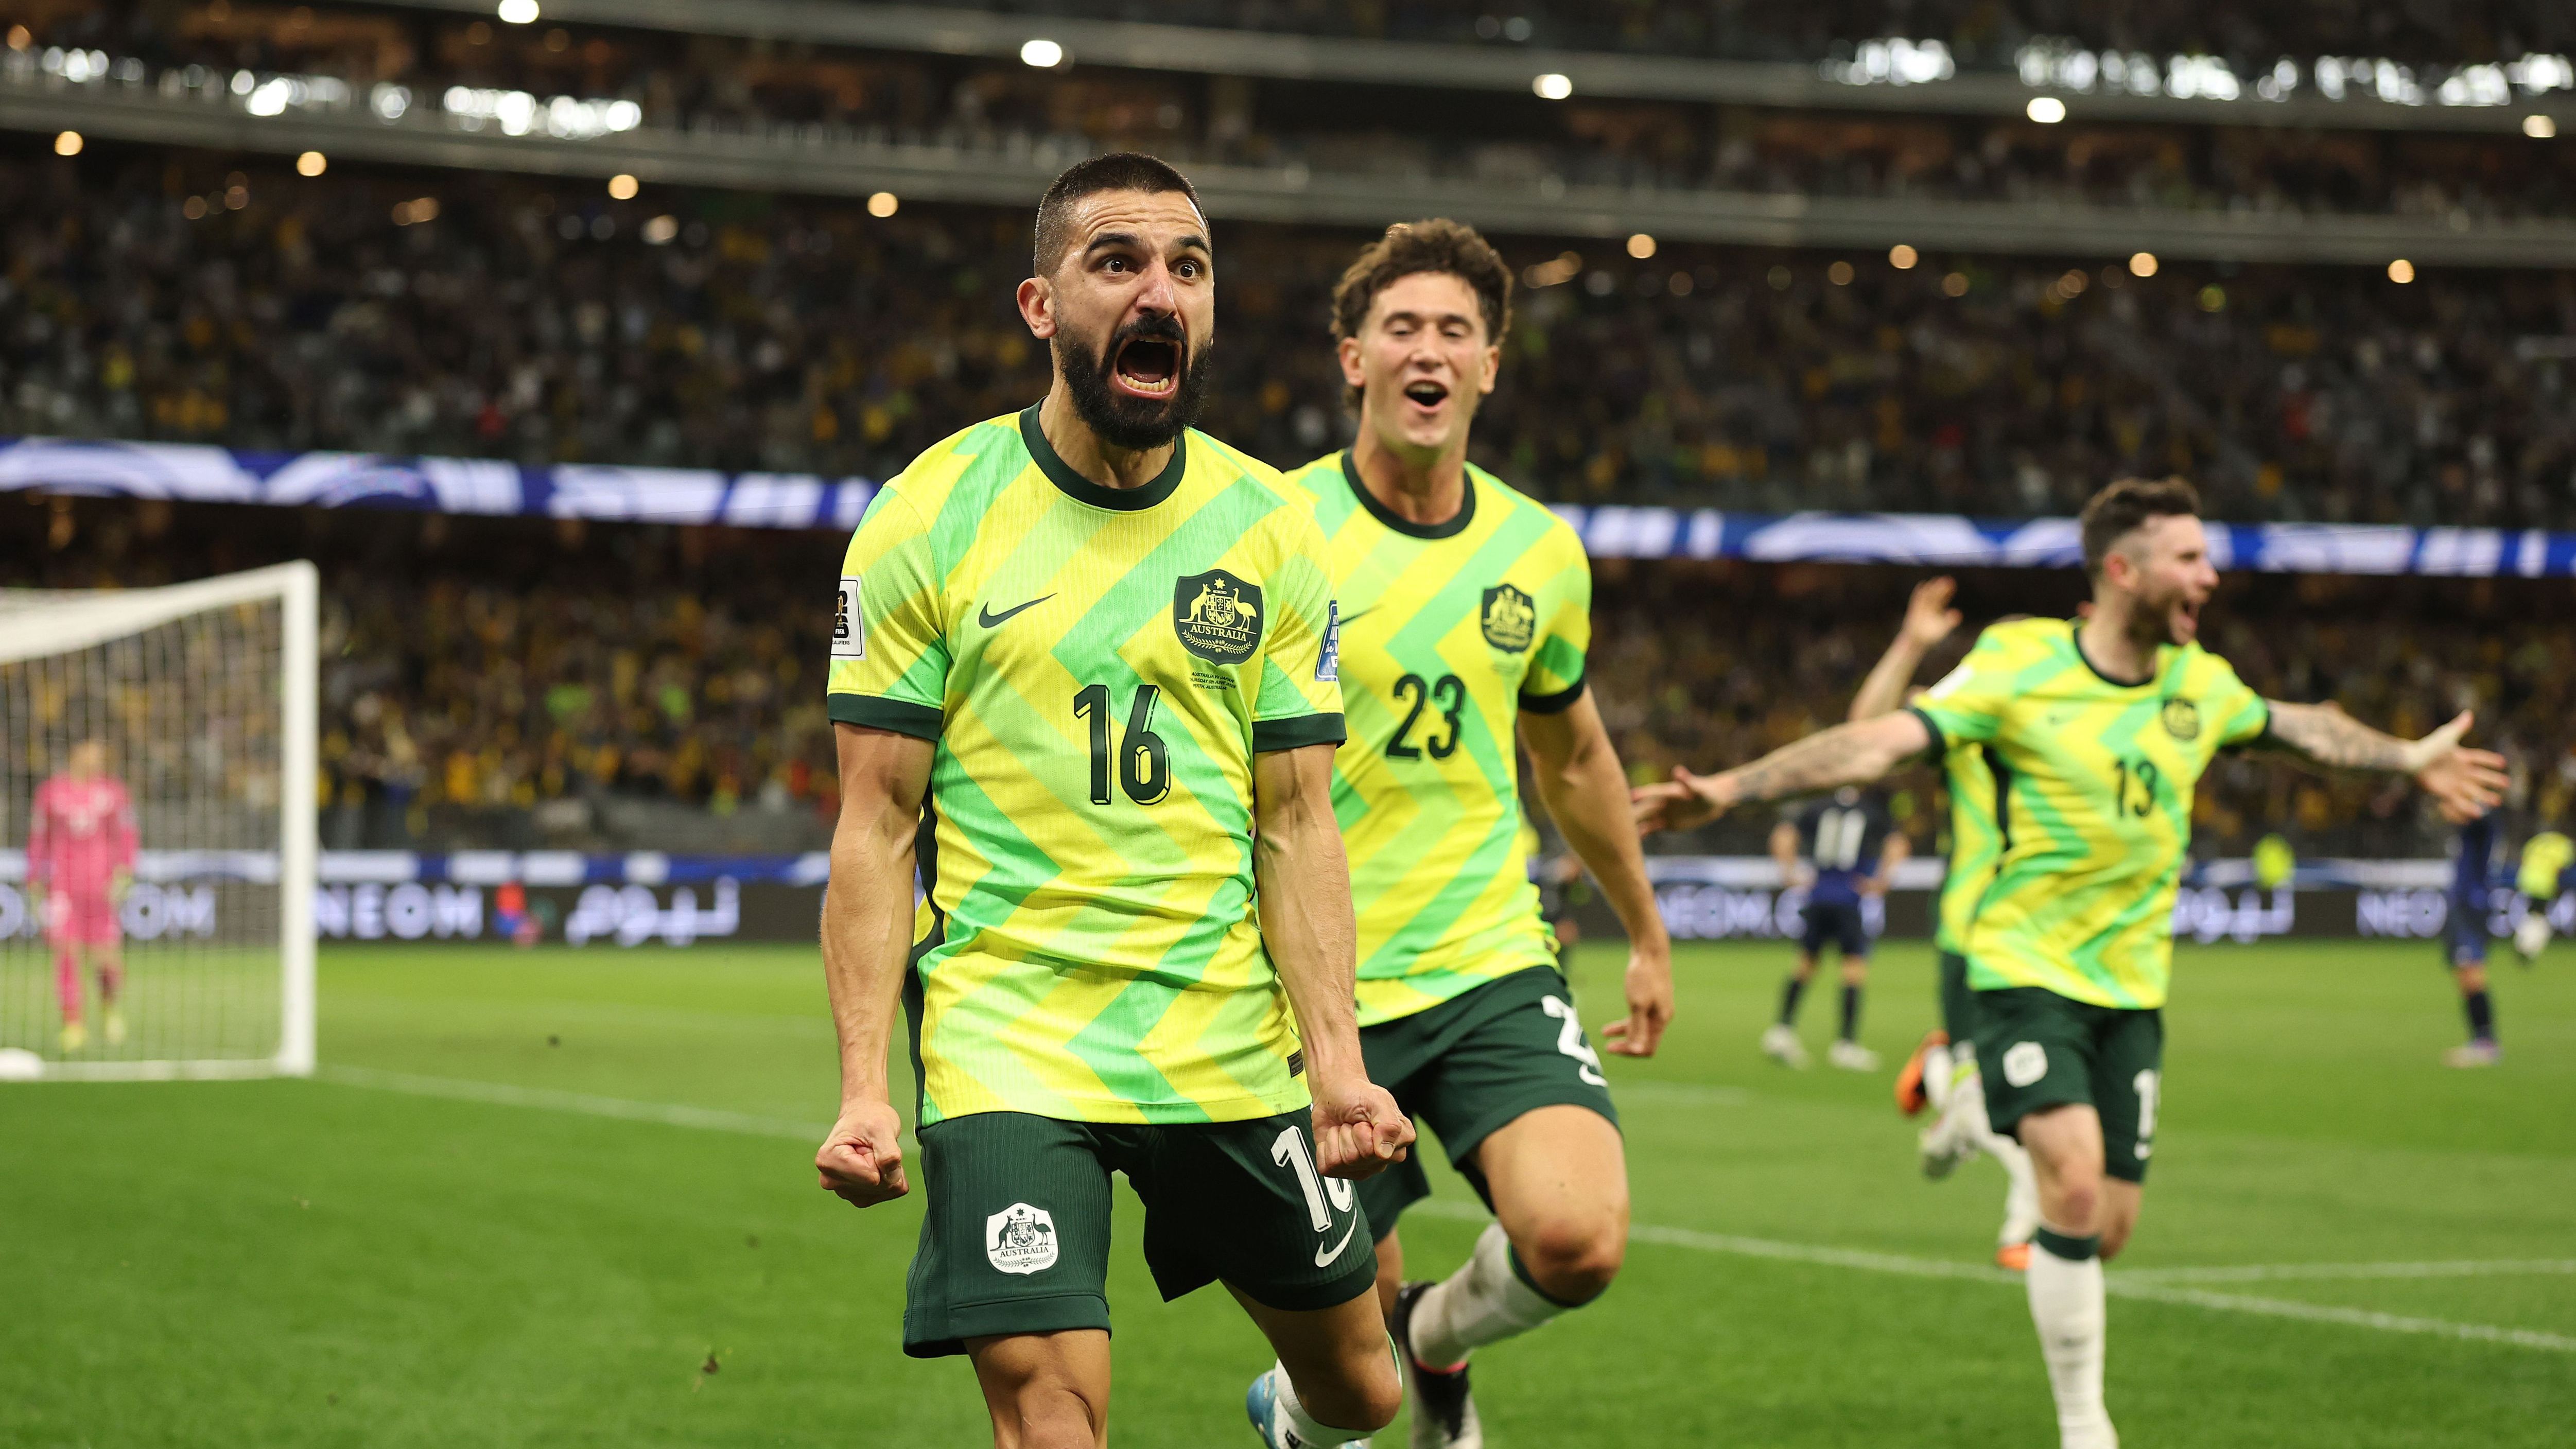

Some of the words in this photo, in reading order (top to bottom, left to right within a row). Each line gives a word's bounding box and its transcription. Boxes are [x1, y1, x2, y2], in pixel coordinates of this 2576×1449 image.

[1190, 624, 1246, 641] AUSTRALIA
[1074, 684, 1171, 805] 16
[1385, 673, 1467, 761] 23
[2114, 759, 2157, 817] 13
[1815, 807, 1866, 871] 11
[311, 881, 483, 940] NEOM
[1541, 994, 1603, 1074] 2
[2132, 1069, 2162, 1139] 1
[1000, 1247, 1049, 1258] AUSTRALIA
